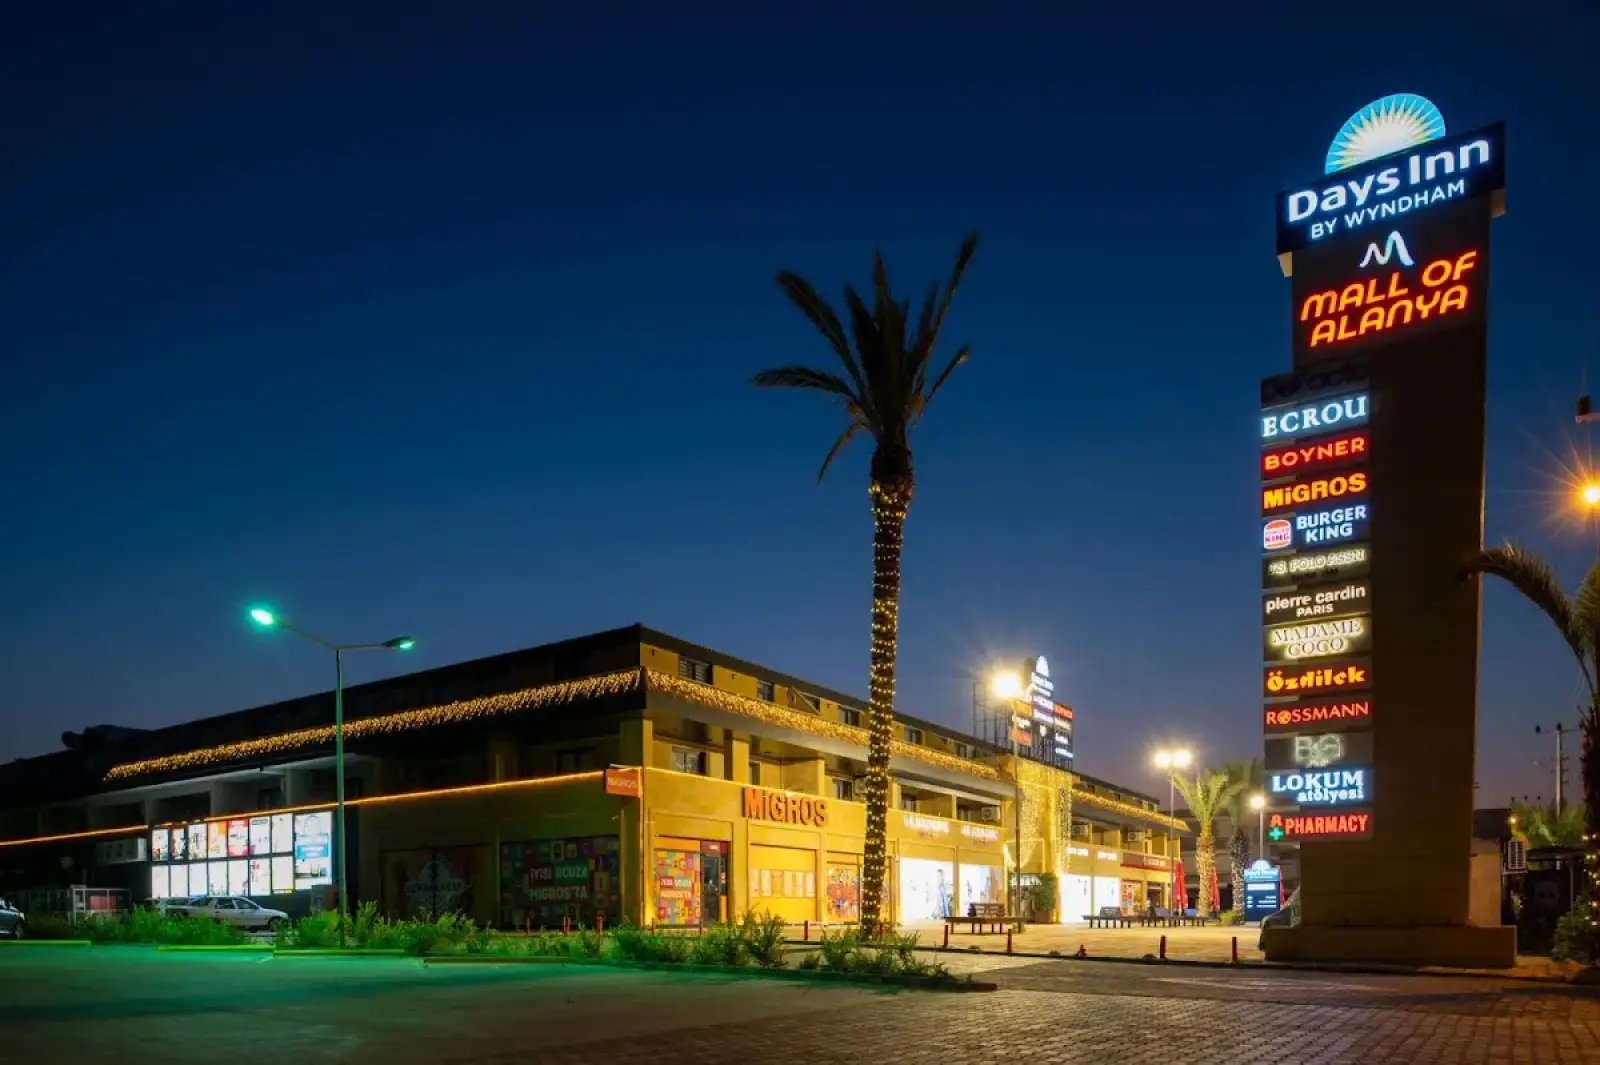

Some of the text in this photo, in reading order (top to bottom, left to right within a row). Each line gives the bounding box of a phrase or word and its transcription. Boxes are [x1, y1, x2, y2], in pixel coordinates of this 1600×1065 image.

[1288, 139, 1489, 222] Days Inn
[1311, 179, 1465, 240] BY WYNDHAM
[1300, 250, 1477, 321] MALL OF
[1310, 284, 1469, 347] ALANYA
[1262, 396, 1368, 437] ECROU
[1264, 437, 1366, 471] BOYNER
[1296, 504, 1367, 530] BURGER
[1305, 523, 1353, 544] KING
[1289, 555, 1326, 573] POLO
[1266, 586, 1366, 614] pierre cardin
[1296, 604, 1334, 617] PARIS
[1273, 619, 1361, 643] MADAME
[1287, 637, 1345, 656] COCO
[1267, 666, 1366, 692] Özdilek
[1266, 701, 1369, 725] ROSSMANN
[1272, 770, 1364, 792] LOKUM
[1285, 813, 1368, 835] PHARMACY
